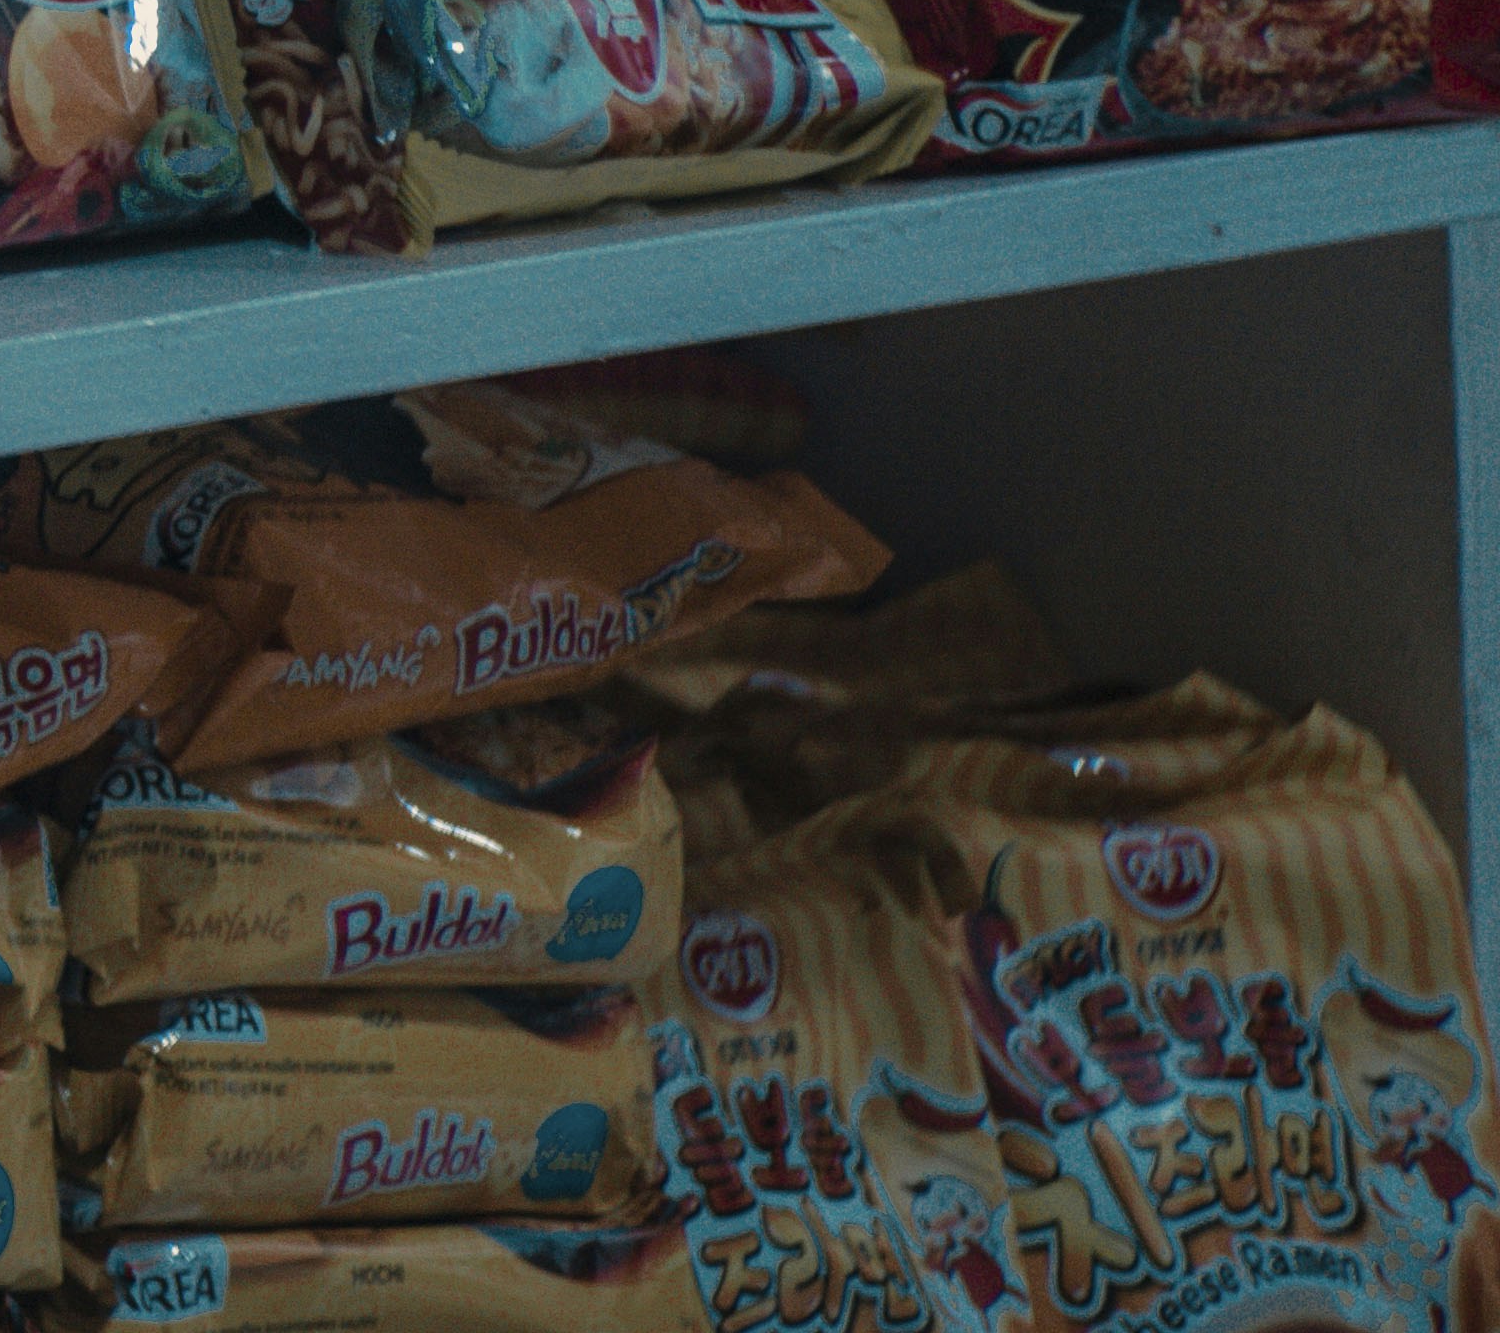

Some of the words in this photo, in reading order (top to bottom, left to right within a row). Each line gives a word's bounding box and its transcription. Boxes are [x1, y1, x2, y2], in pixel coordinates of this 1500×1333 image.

[453, 590, 620, 696] Buldak
[326, 881, 520, 982] Buldak
[179, 1000, 263, 1036] REA
[1018, 970, 1308, 1123] 보들보들
[322, 1107, 498, 1210] Buldak
[672, 1075, 856, 1219] 들보들
[1001, 1084, 1347, 1305] 치즈라면
[700, 1201, 923, 1331] 즈라면
[1122, 1260, 1241, 1333] heese
[1240, 1240, 1364, 1286] Ramen
